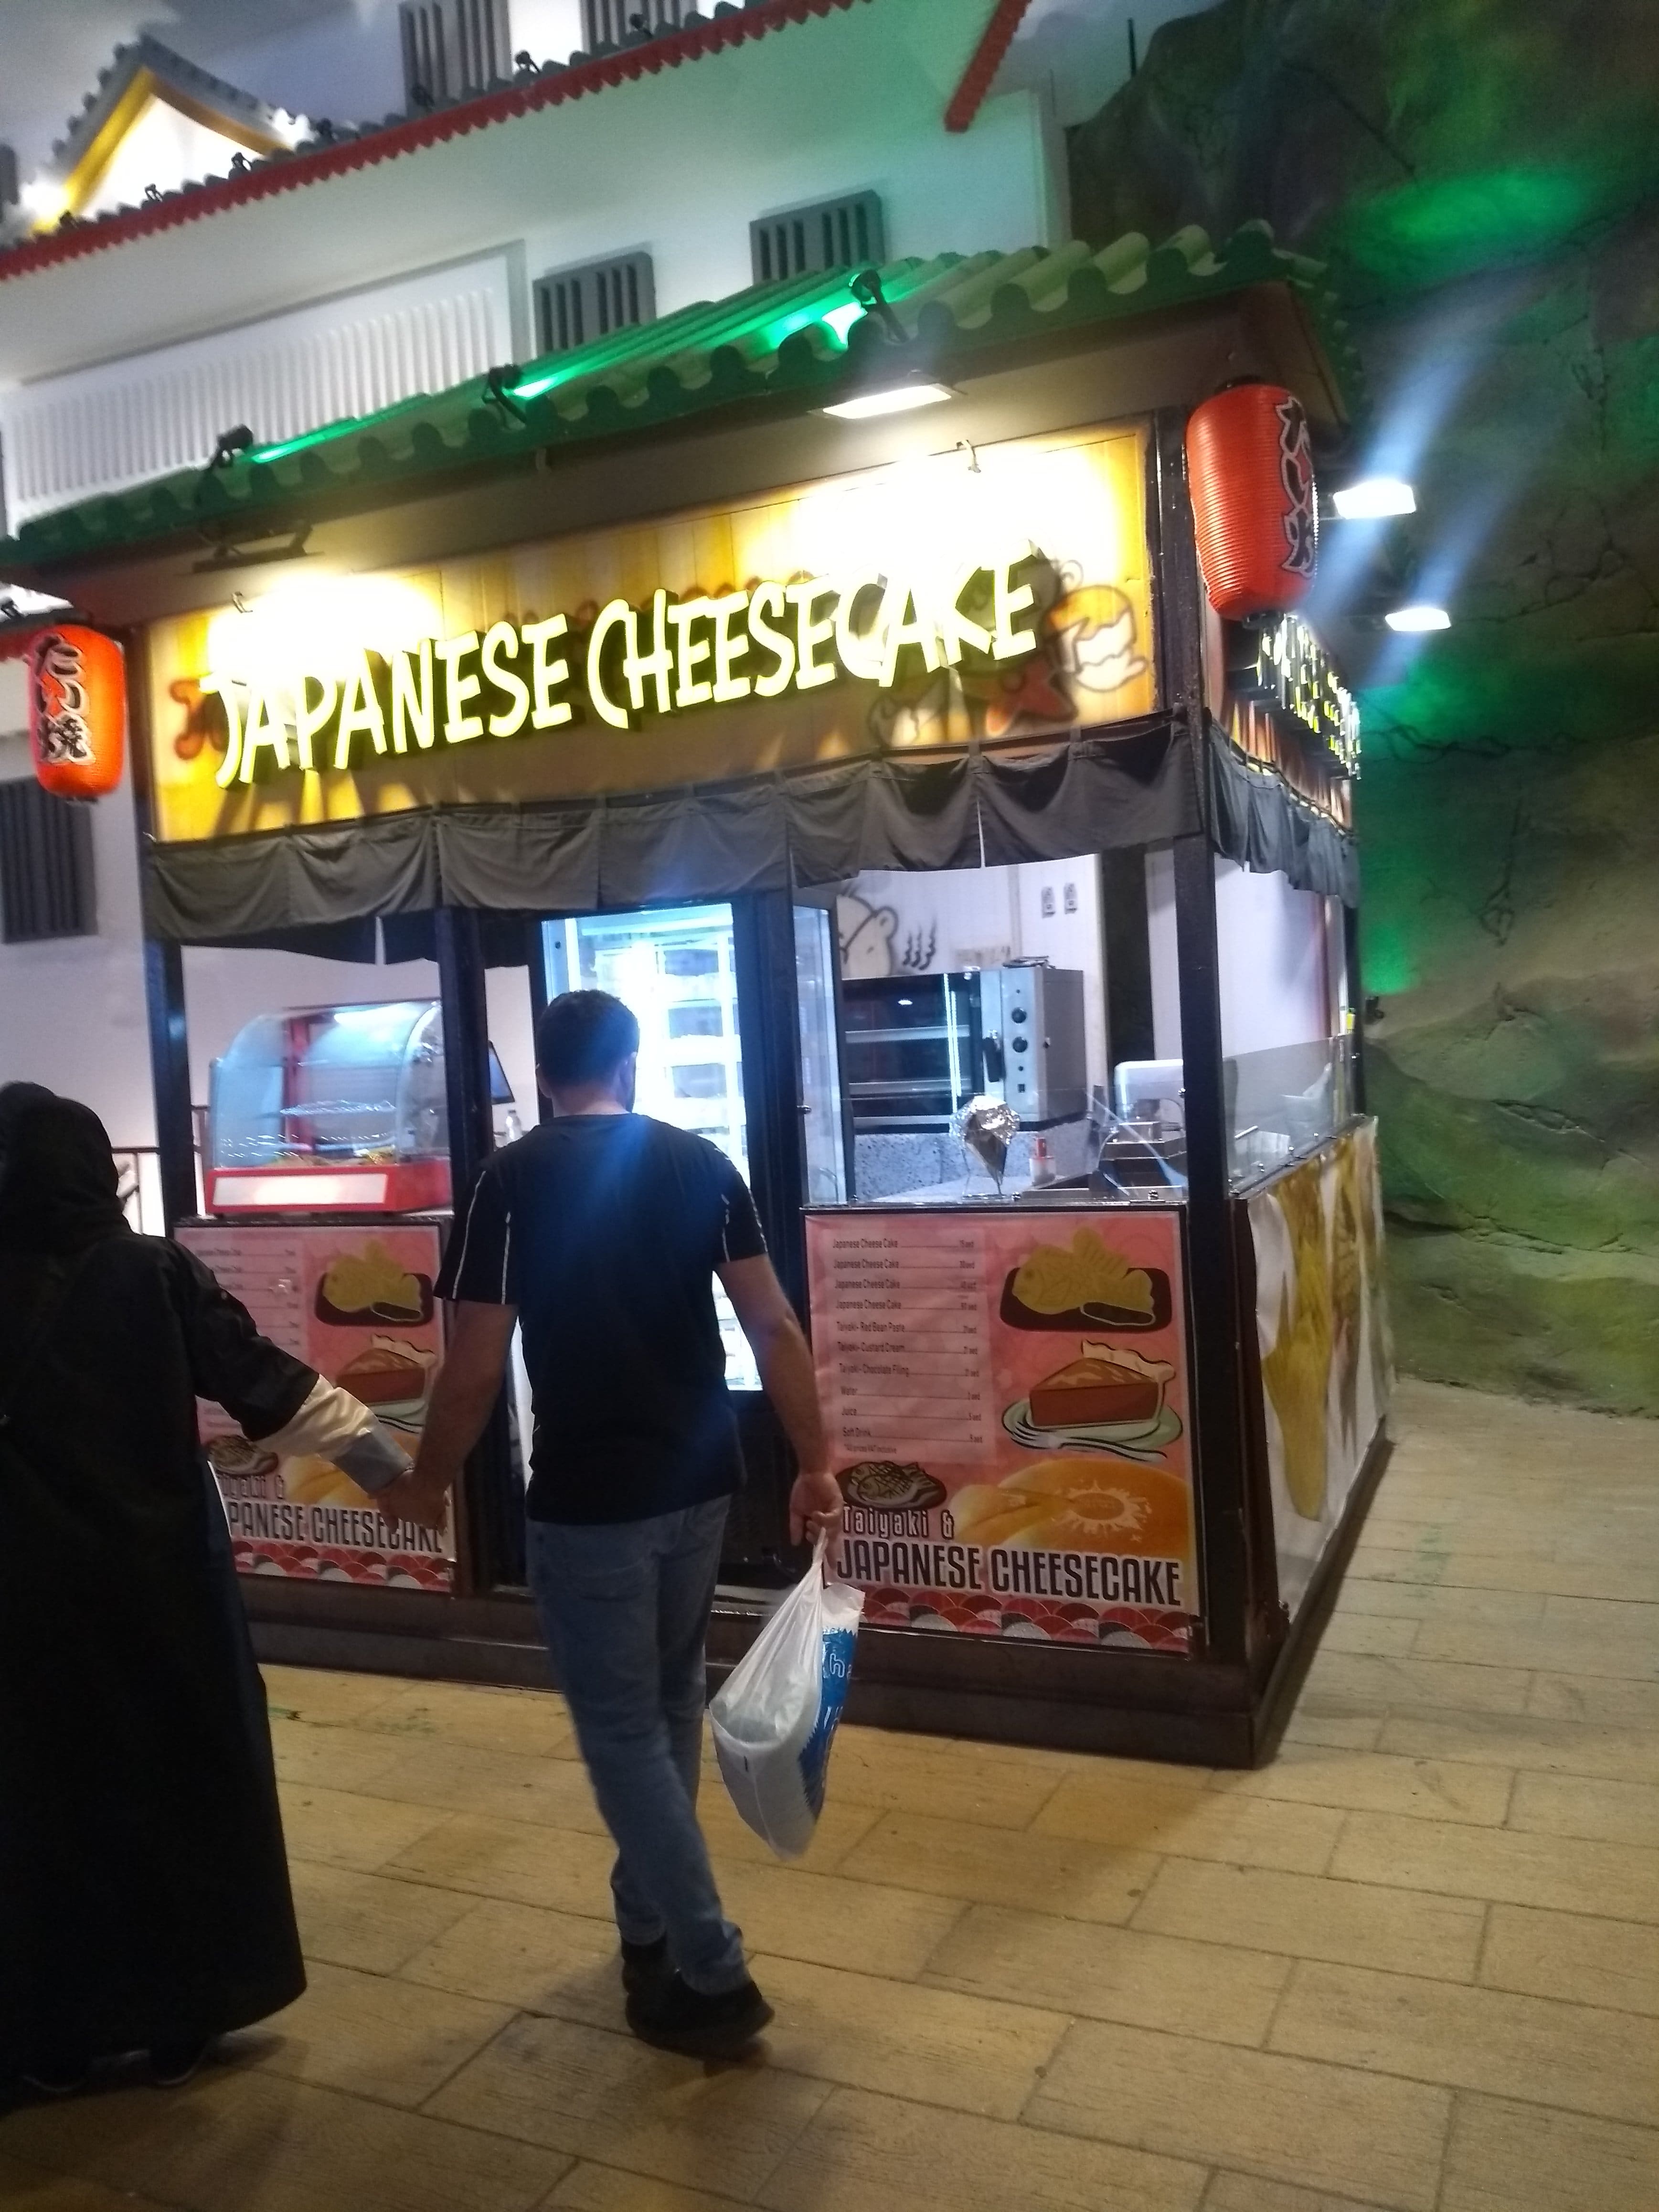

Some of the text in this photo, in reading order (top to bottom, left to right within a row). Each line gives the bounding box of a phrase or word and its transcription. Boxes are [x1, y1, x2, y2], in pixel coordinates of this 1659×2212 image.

[199, 611, 572, 789] JAPANESE
[586, 541, 1039, 729] CHEESECAKE
[833, 1239, 860, 1249] Japanese
[861, 1238, 883, 1248] Cheese
[883, 1238, 898, 1248] Cake
[834, 1259, 861, 1269] Japanese
[862, 1259, 883, 1268] Cheese
[885, 1259, 899, 1268] Cake
[835, 1279, 861, 1289] Japanese
[863, 1279, 884, 1288] Cheese
[886, 1279, 900, 1288] Cake
[836, 1300, 863, 1310] Japanese
[864, 1299, 885, 1309] Cheese
[887, 1299, 901, 1309] Cake
[843, 1506, 954, 1540] Taiyaki &
[837, 1539, 1181, 1606] JAPANESE CHEESECAKE
